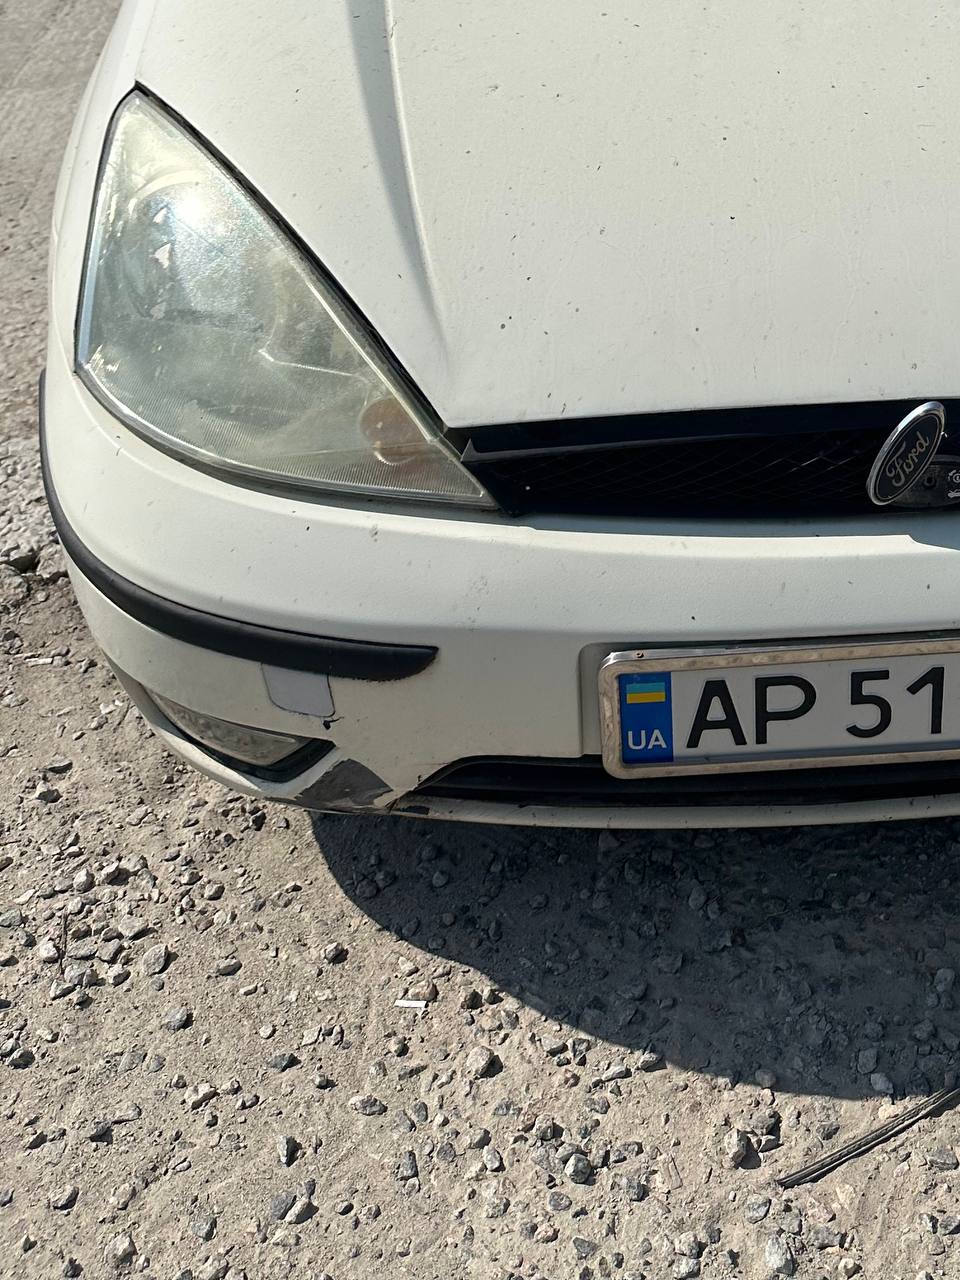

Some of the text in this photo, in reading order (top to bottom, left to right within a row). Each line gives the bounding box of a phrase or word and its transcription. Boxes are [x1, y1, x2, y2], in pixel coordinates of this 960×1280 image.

[885, 430, 930, 487] Ford
[627, 728, 668, 750] UA
[685, 675, 818, 749] AP
